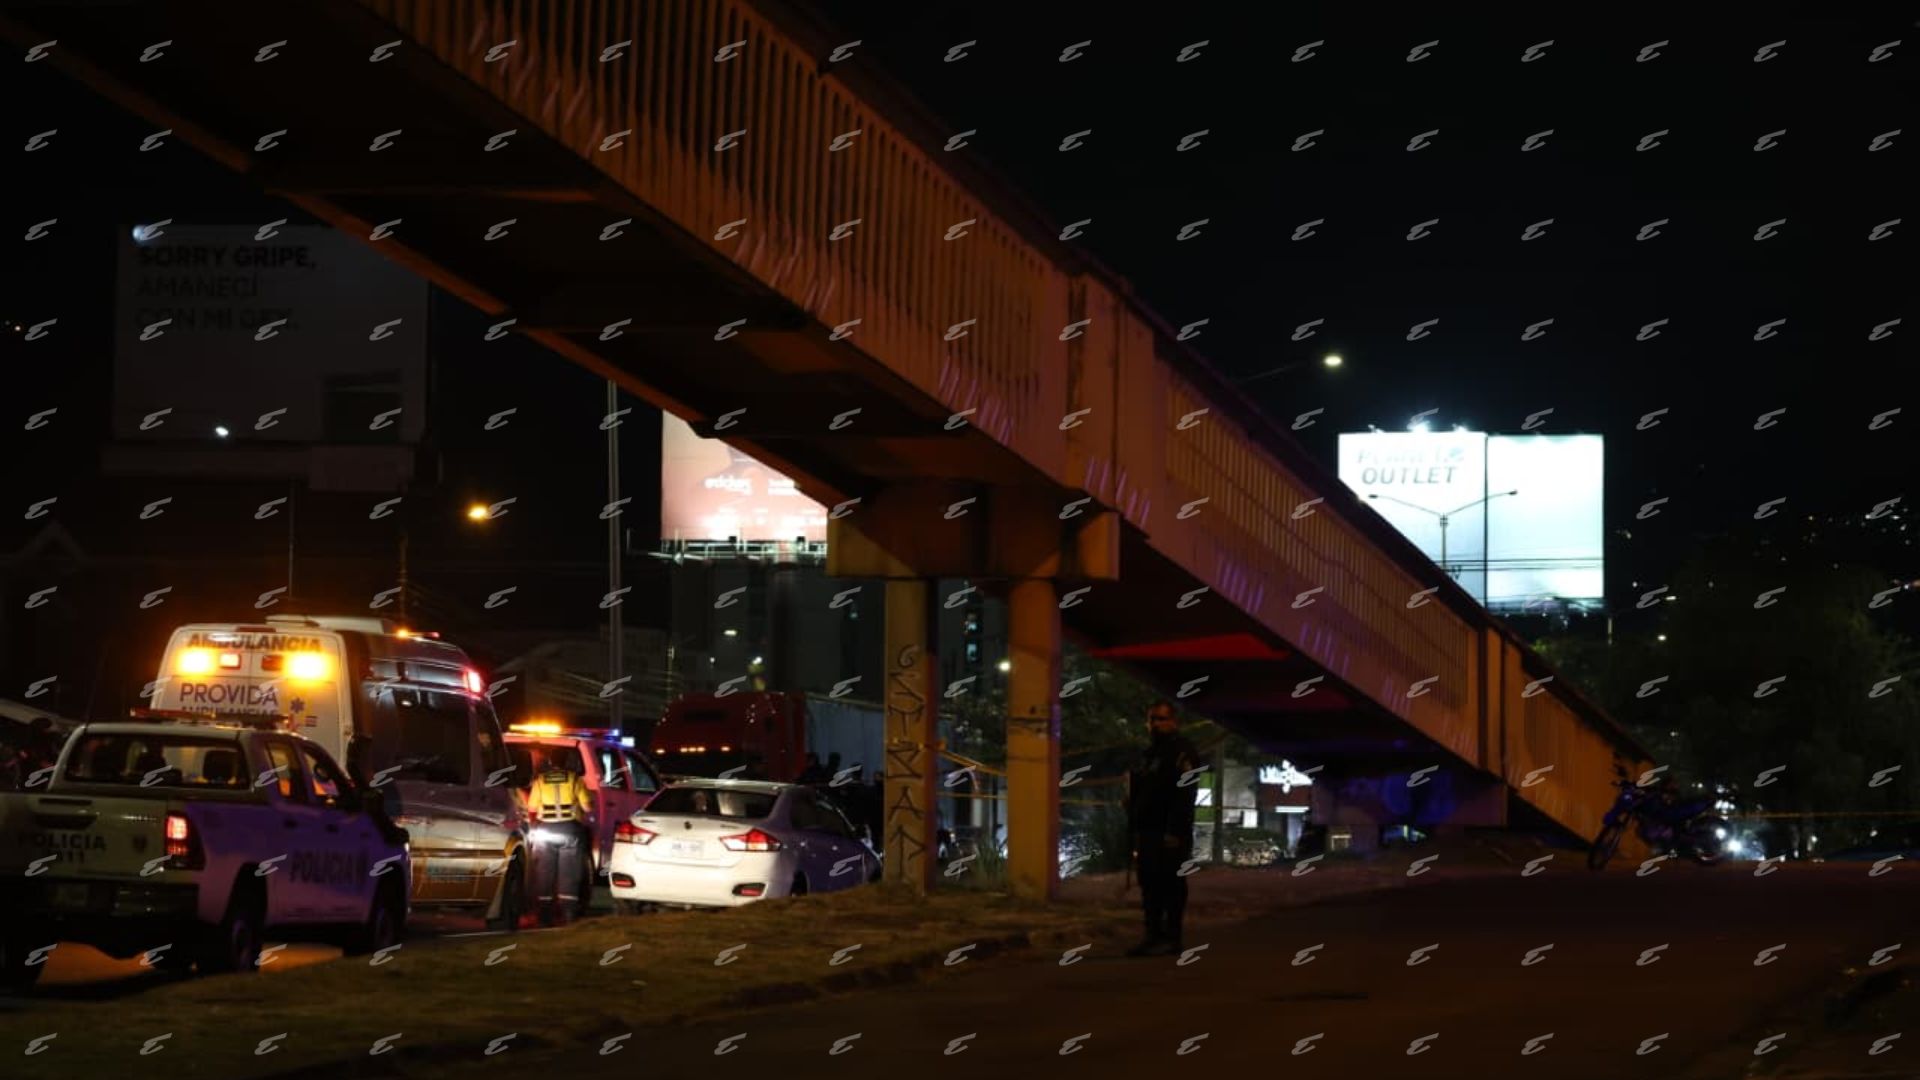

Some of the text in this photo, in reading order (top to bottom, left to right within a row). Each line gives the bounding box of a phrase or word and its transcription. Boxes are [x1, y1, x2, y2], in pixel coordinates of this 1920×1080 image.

[137, 246, 317, 270] SORRY GRIPE,
[1361, 466, 1459, 485] OUTLET
[180, 682, 279, 706] PROVIDA
